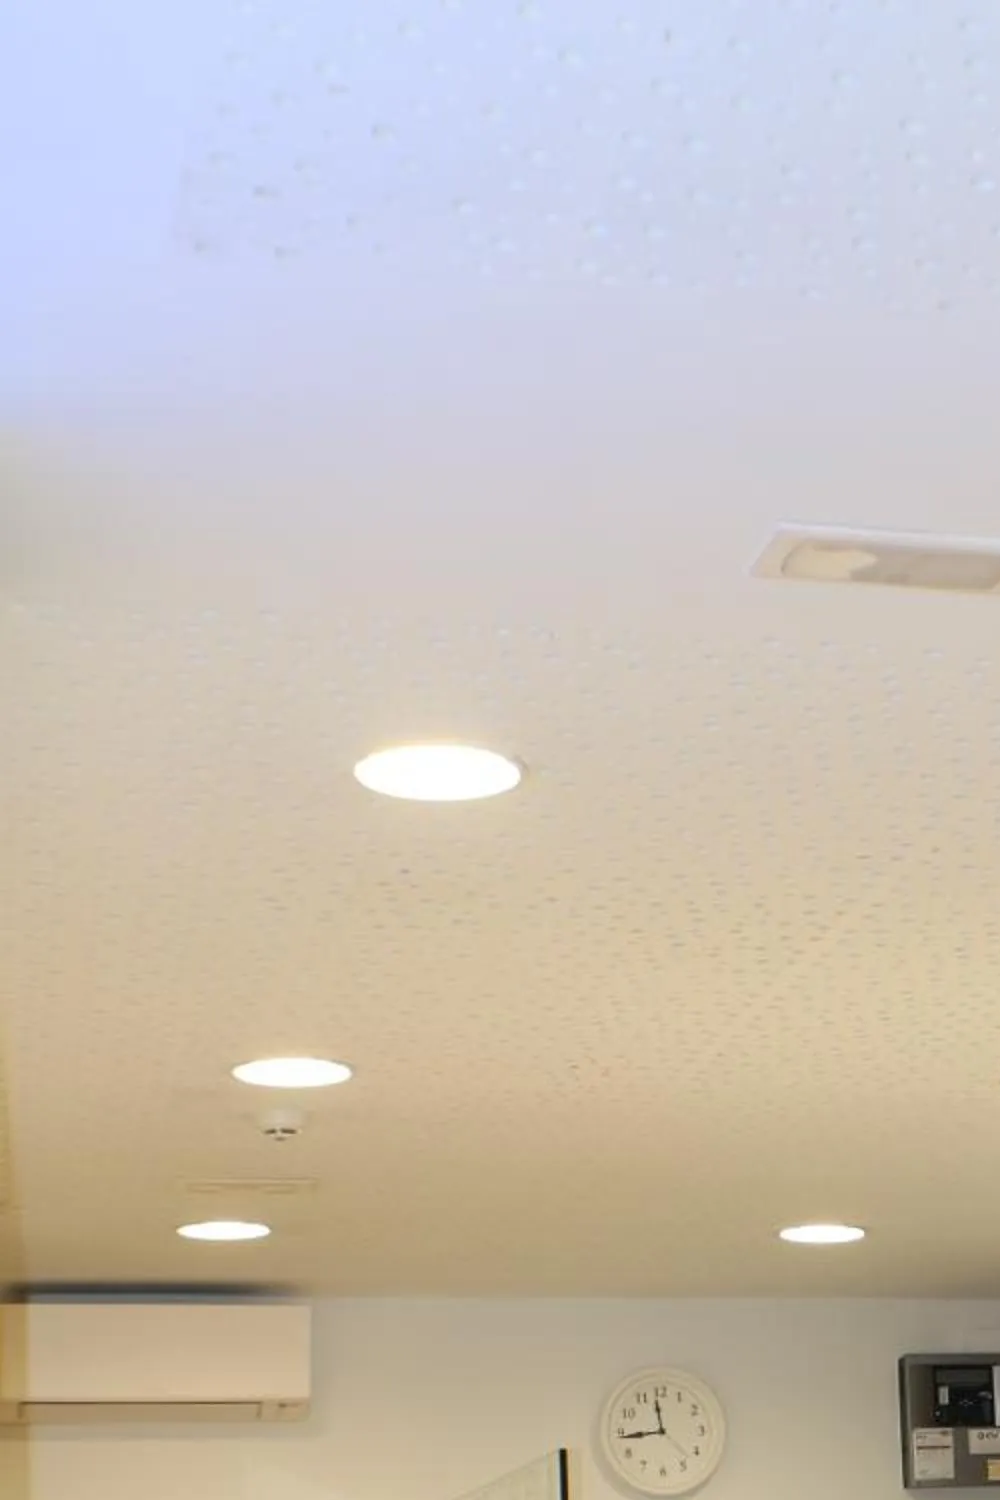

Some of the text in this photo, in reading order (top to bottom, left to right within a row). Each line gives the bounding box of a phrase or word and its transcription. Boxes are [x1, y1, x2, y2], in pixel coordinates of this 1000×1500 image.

[636, 1391, 648, 1404] 11
[653, 1385, 668, 1399] 12
[622, 1407, 636, 1420] 10
[698, 1425, 705, 1437] 3
